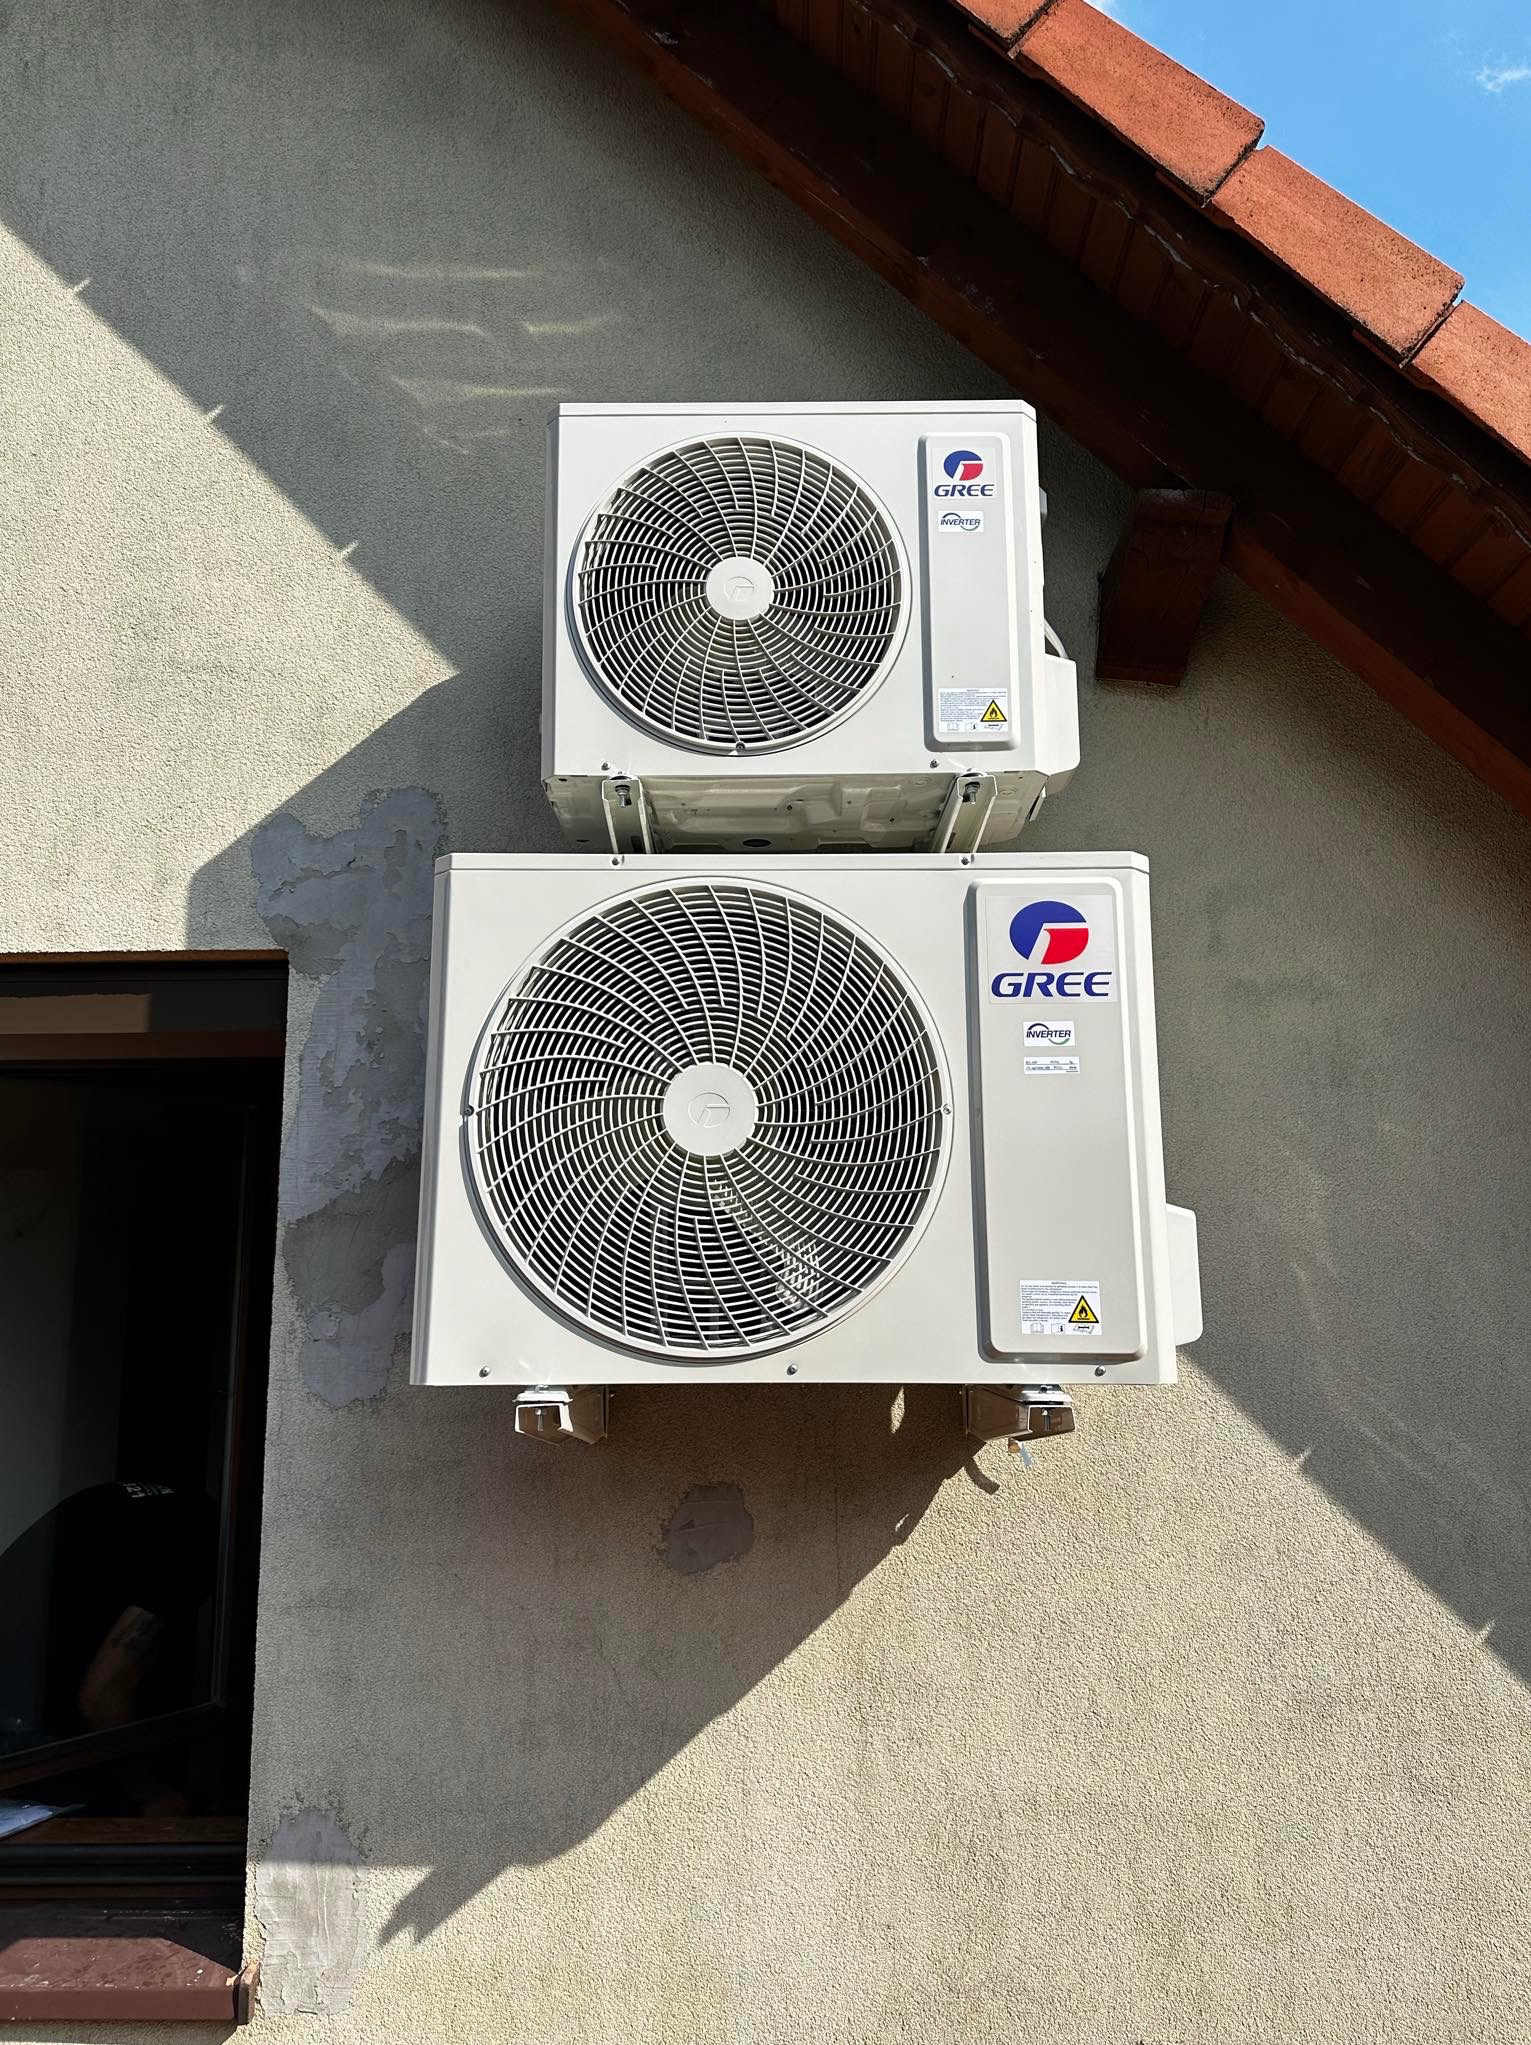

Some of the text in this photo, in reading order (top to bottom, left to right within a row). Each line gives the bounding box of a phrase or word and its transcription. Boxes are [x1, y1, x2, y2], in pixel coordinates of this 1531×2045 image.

[934, 484, 995, 497] GREE
[940, 518, 980, 526] INVERTER
[991, 971, 1112, 998] GREE
[1026, 1029, 1072, 1039] INVERTER
